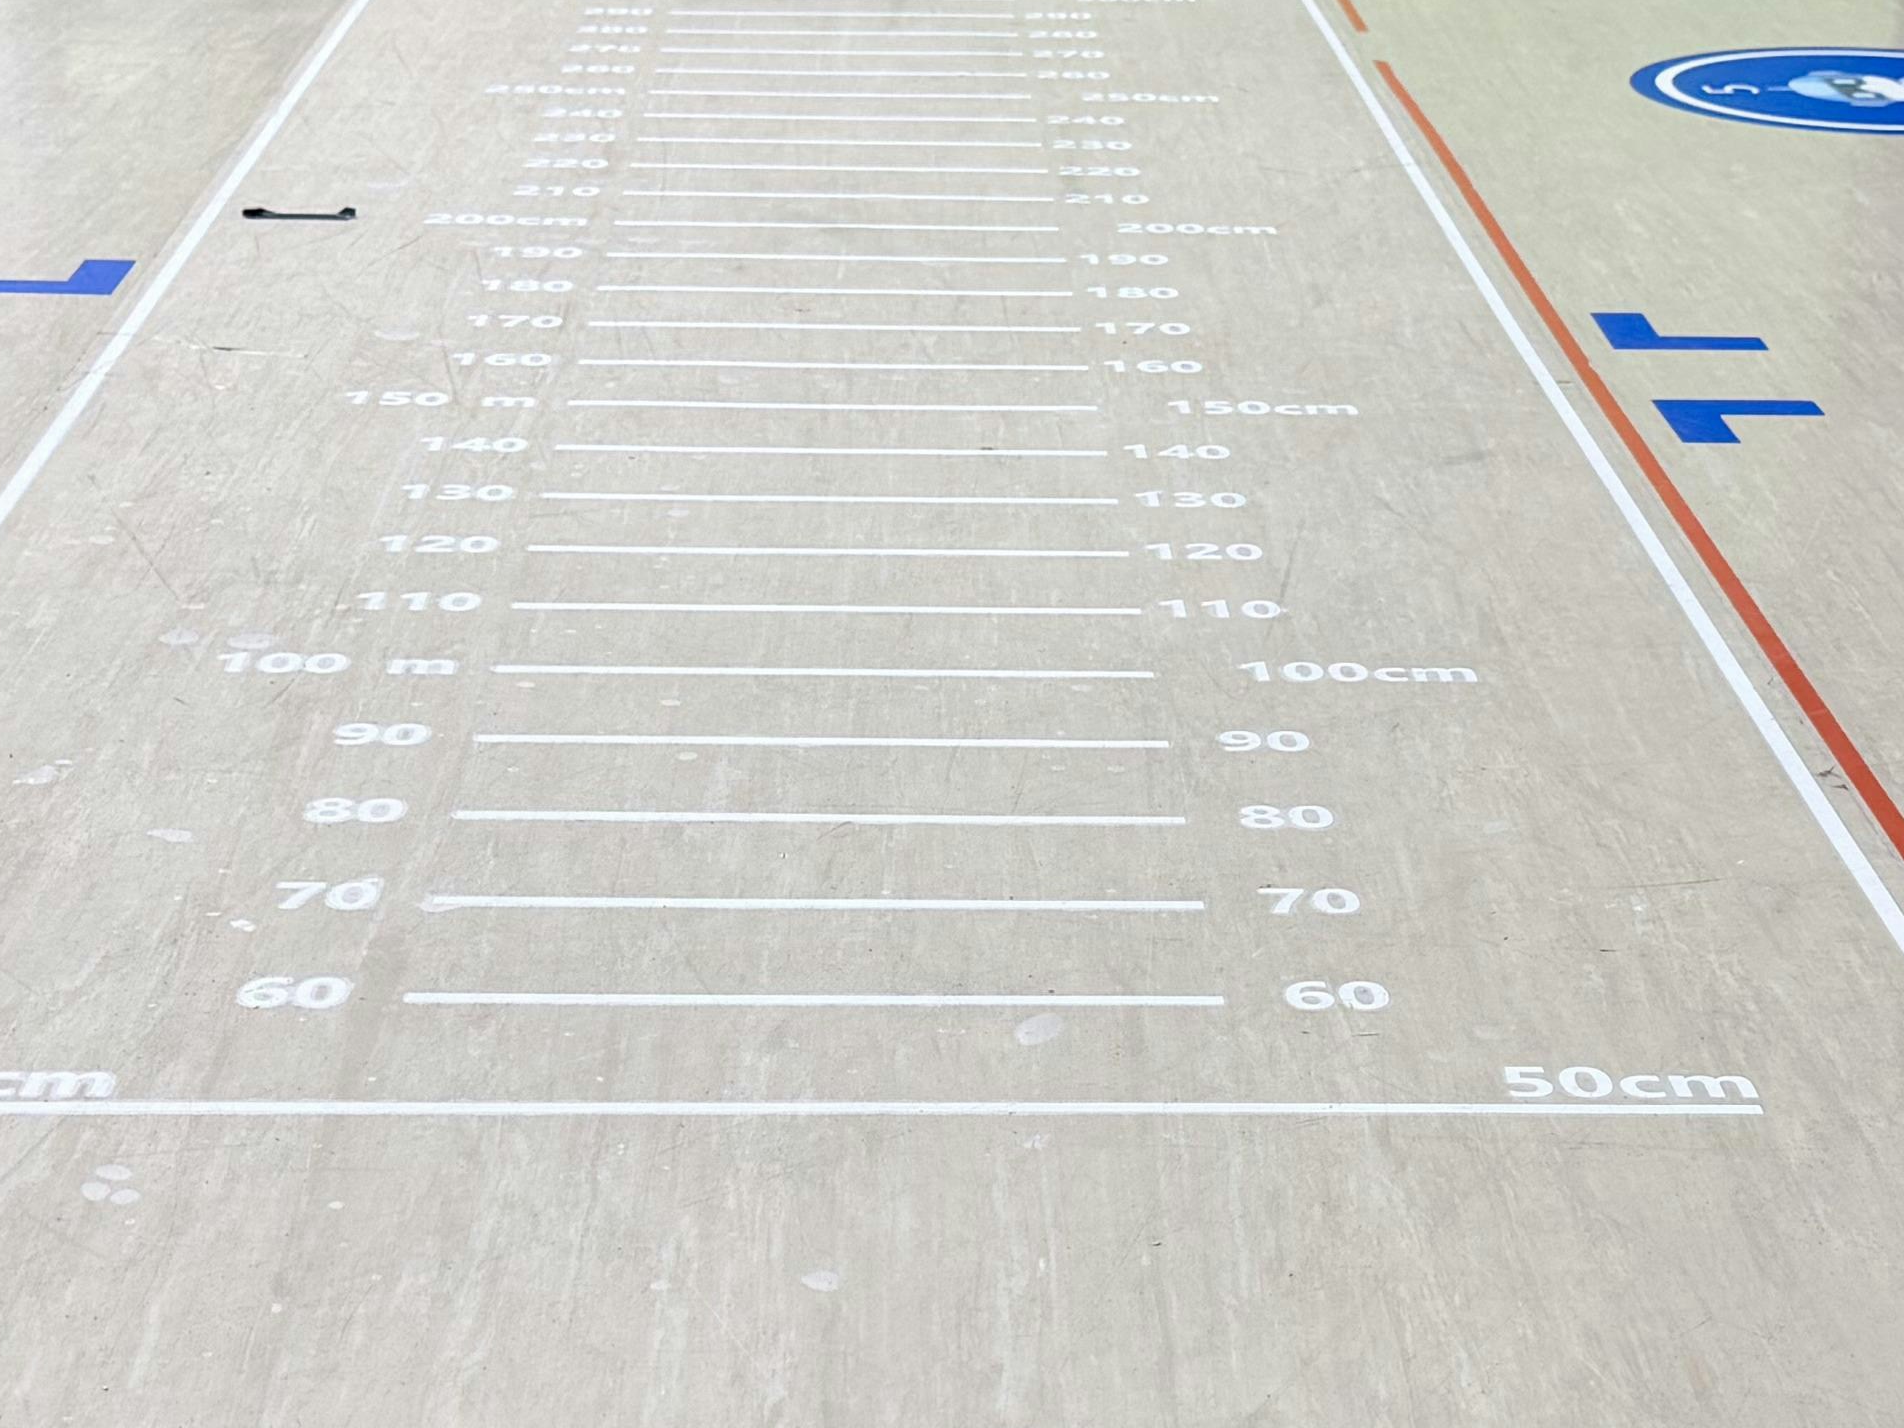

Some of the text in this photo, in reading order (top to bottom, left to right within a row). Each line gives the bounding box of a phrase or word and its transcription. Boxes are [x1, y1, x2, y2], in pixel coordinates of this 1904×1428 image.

[1700, 79, 1761, 100] 5
[523, 158, 609, 170] 220
[1057, 166, 1142, 177] 220
[513, 184, 602, 197] 210
[1064, 193, 1150, 205] 210
[423, 213, 589, 226] 200cm
[1117, 222, 1279, 235] 200cm
[494, 246, 584, 259] 190
[1079, 253, 1169, 266] 190
[481, 279, 575, 293] 180
[1086, 286, 1179, 299] 180
[468, 314, 564, 329] 170
[1095, 321, 1192, 336] 170
[451, 352, 553, 367] 160
[1103, 360, 1203, 374] 160
[1167, 400, 1359, 416] 150cm
[420, 436, 529, 453] 140
[1123, 444, 1231, 460] 140
[401, 483, 515, 502] 130
[1135, 490, 1248, 509] 130
[380, 534, 501, 554] 120
[1145, 542, 1264, 561] 120
[358, 591, 482, 612] 110
[1157, 599, 1283, 619] 110
[1237, 661, 1479, 683] 100cm
[333, 722, 433, 747] 90
[1216, 730, 1311, 753] 90
[303, 797, 408, 824] 80
[1238, 804, 1336, 830] 80
[276, 876, 384, 912] 70
[1256, 887, 1361, 915] 70
[237, 976, 354, 1010] 60
[1284, 980, 1392, 1012] 60
[1503, 1065, 1759, 1100] 50cm
